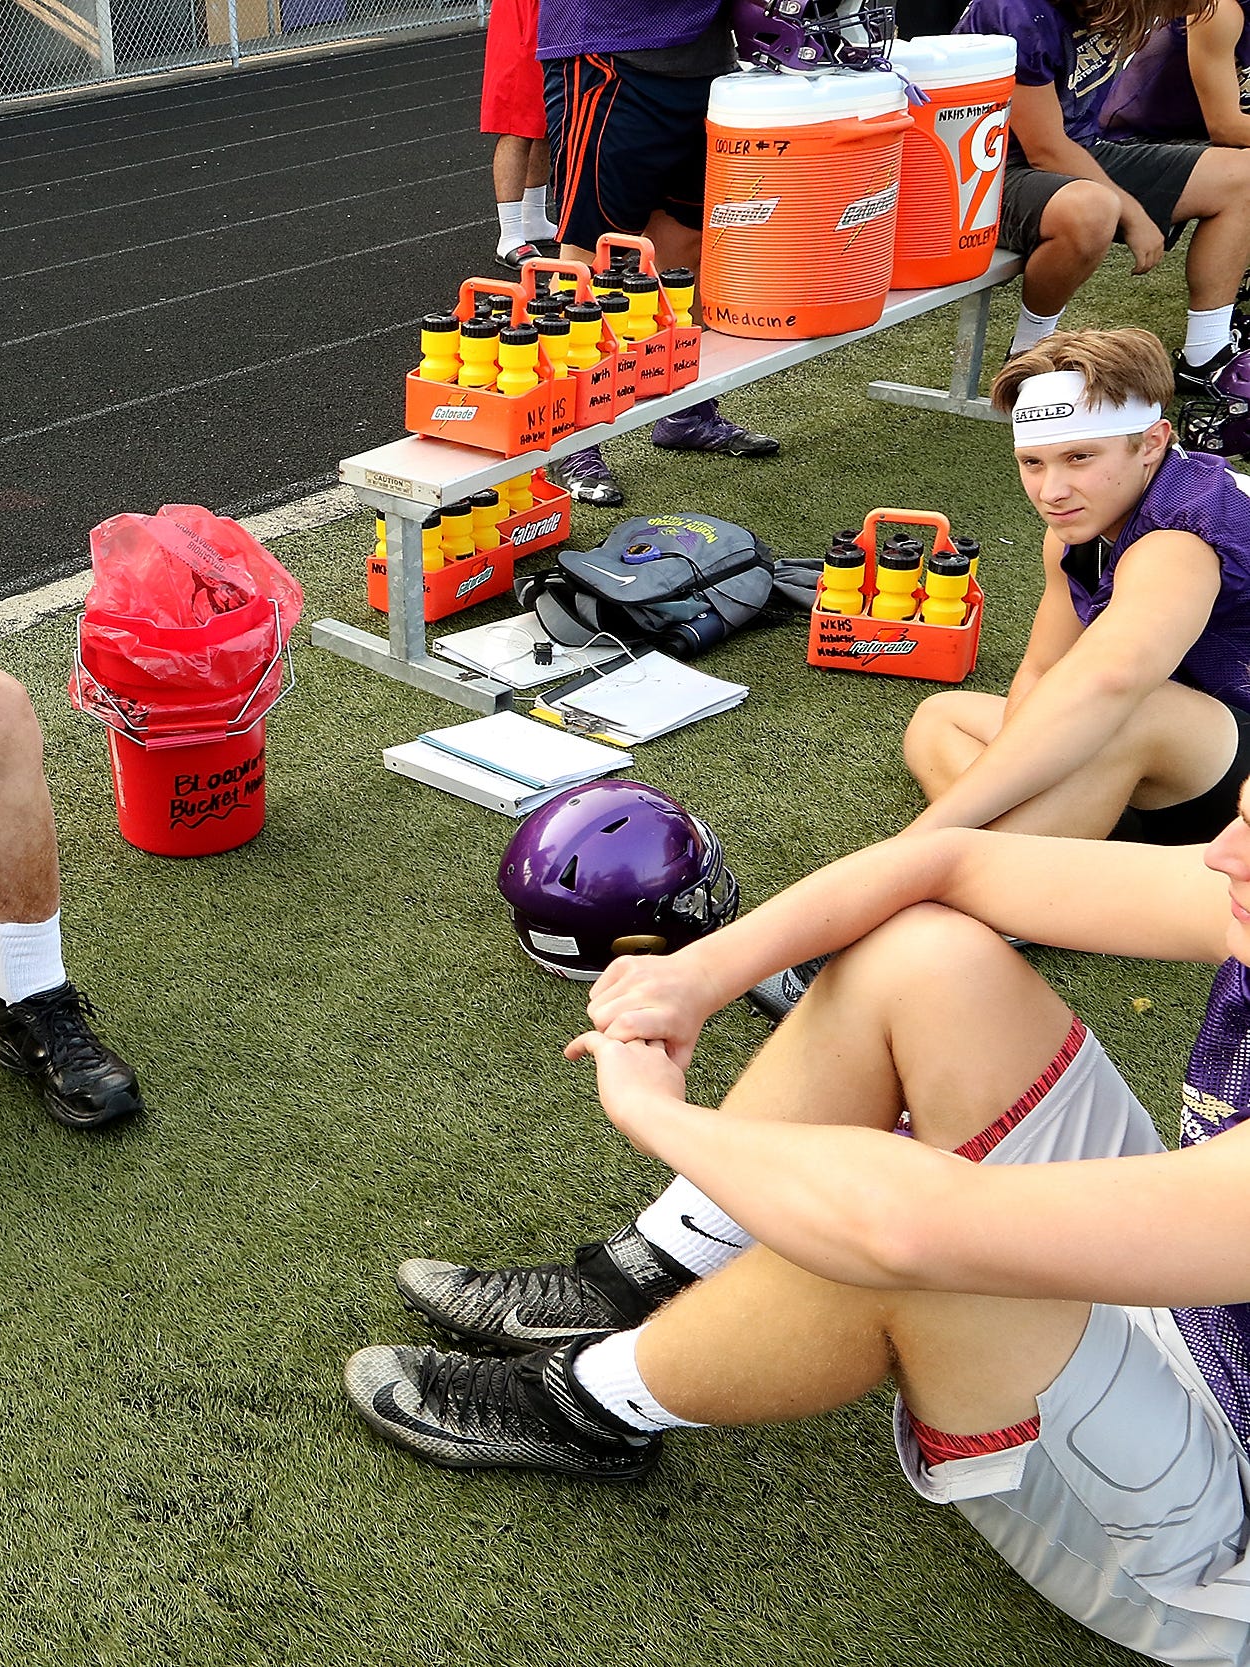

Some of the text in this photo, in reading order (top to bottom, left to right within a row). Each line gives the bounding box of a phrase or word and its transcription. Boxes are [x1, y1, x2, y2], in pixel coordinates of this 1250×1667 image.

[715, 138, 751, 155] COOLER
[970, 108, 1006, 172] G
[716, 307, 797, 328] Medicine
[434, 407, 474, 421] Gatorade
[373, 475, 404, 487] CAUTION
[820, 618, 853, 632] NKHS
[850, 641, 917, 655] Gatorade
